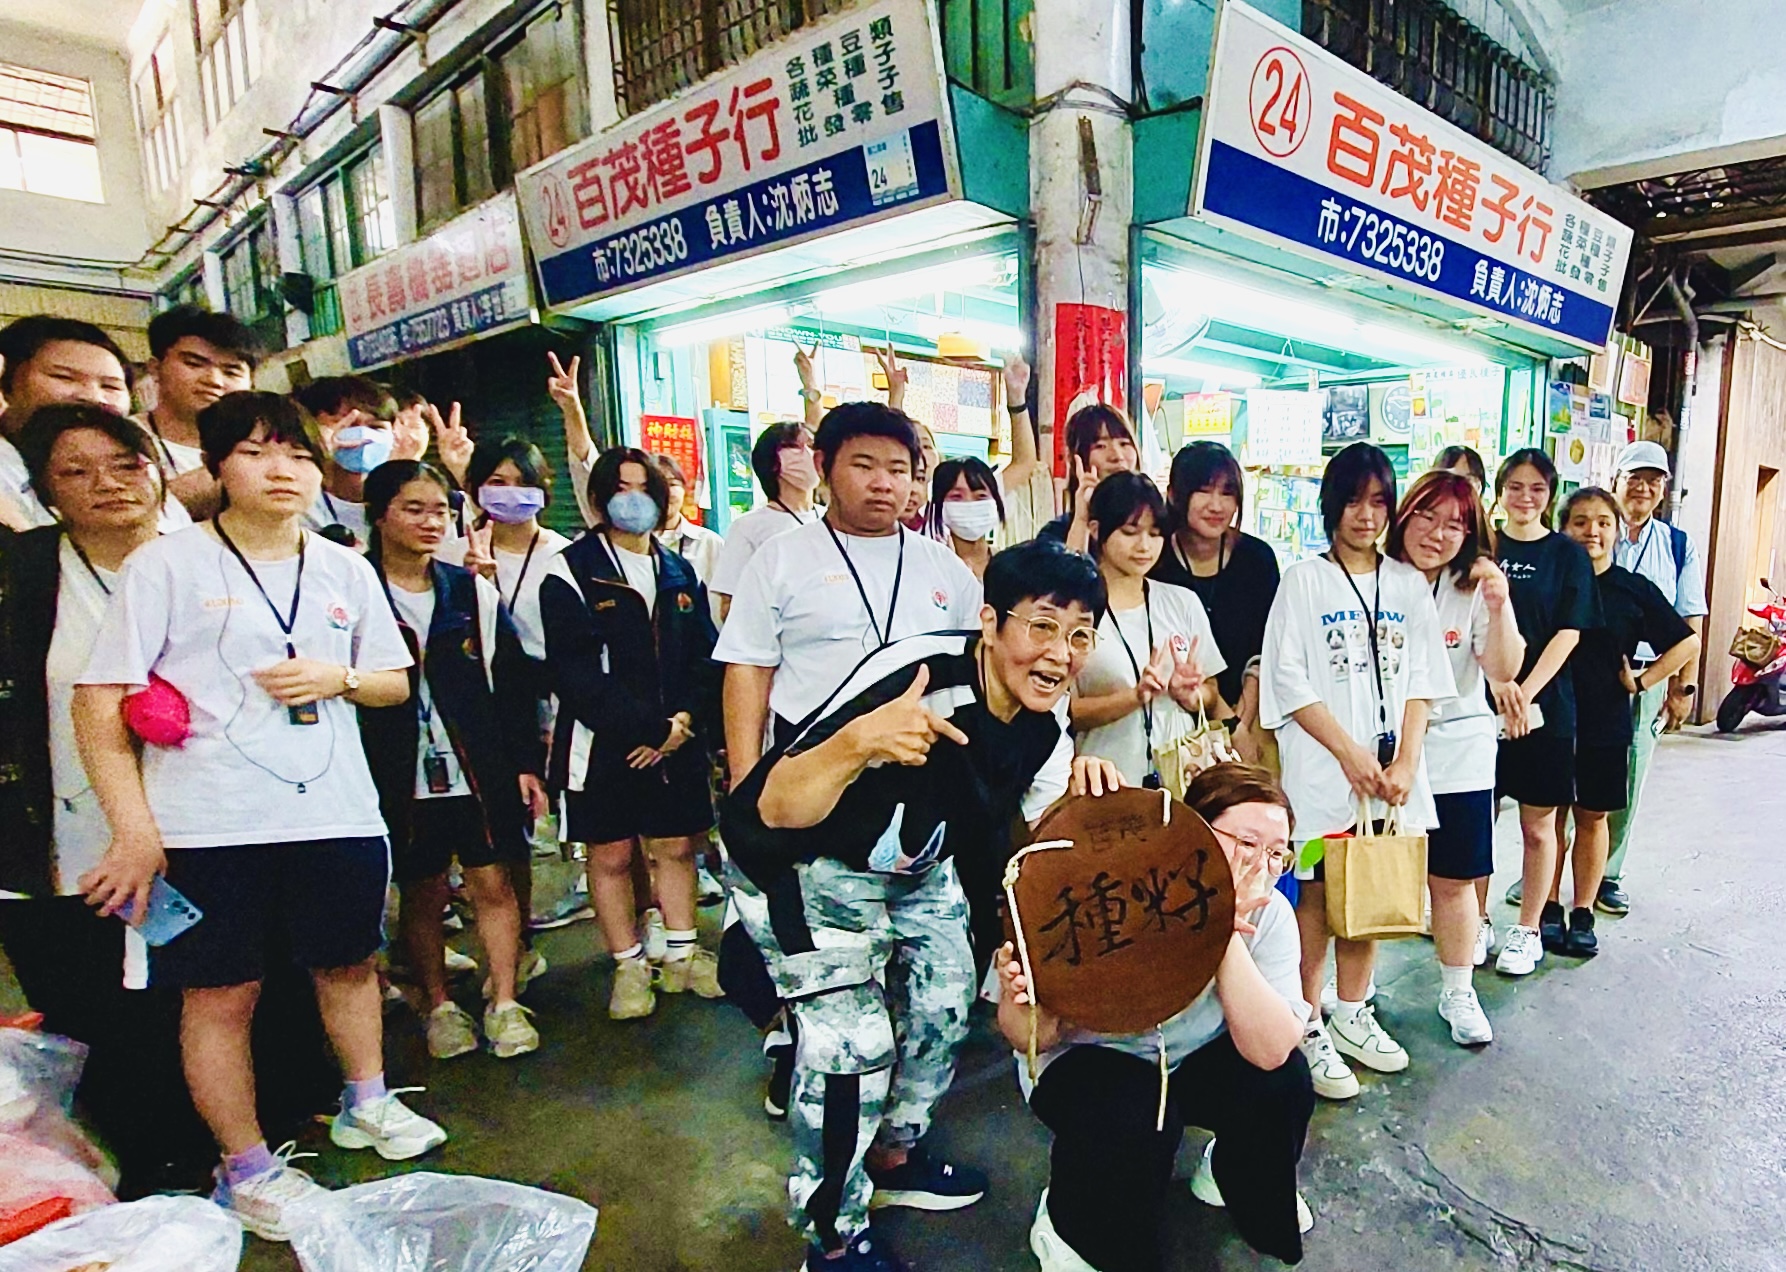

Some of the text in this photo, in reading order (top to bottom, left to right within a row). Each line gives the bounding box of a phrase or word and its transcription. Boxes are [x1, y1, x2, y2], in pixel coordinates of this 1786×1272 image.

[540, 182, 568, 238] 24
[567, 77, 780, 231] 百茂種子行
[871, 166, 888, 189] 24
[1258, 57, 1555, 265] 24 百茂種子行
